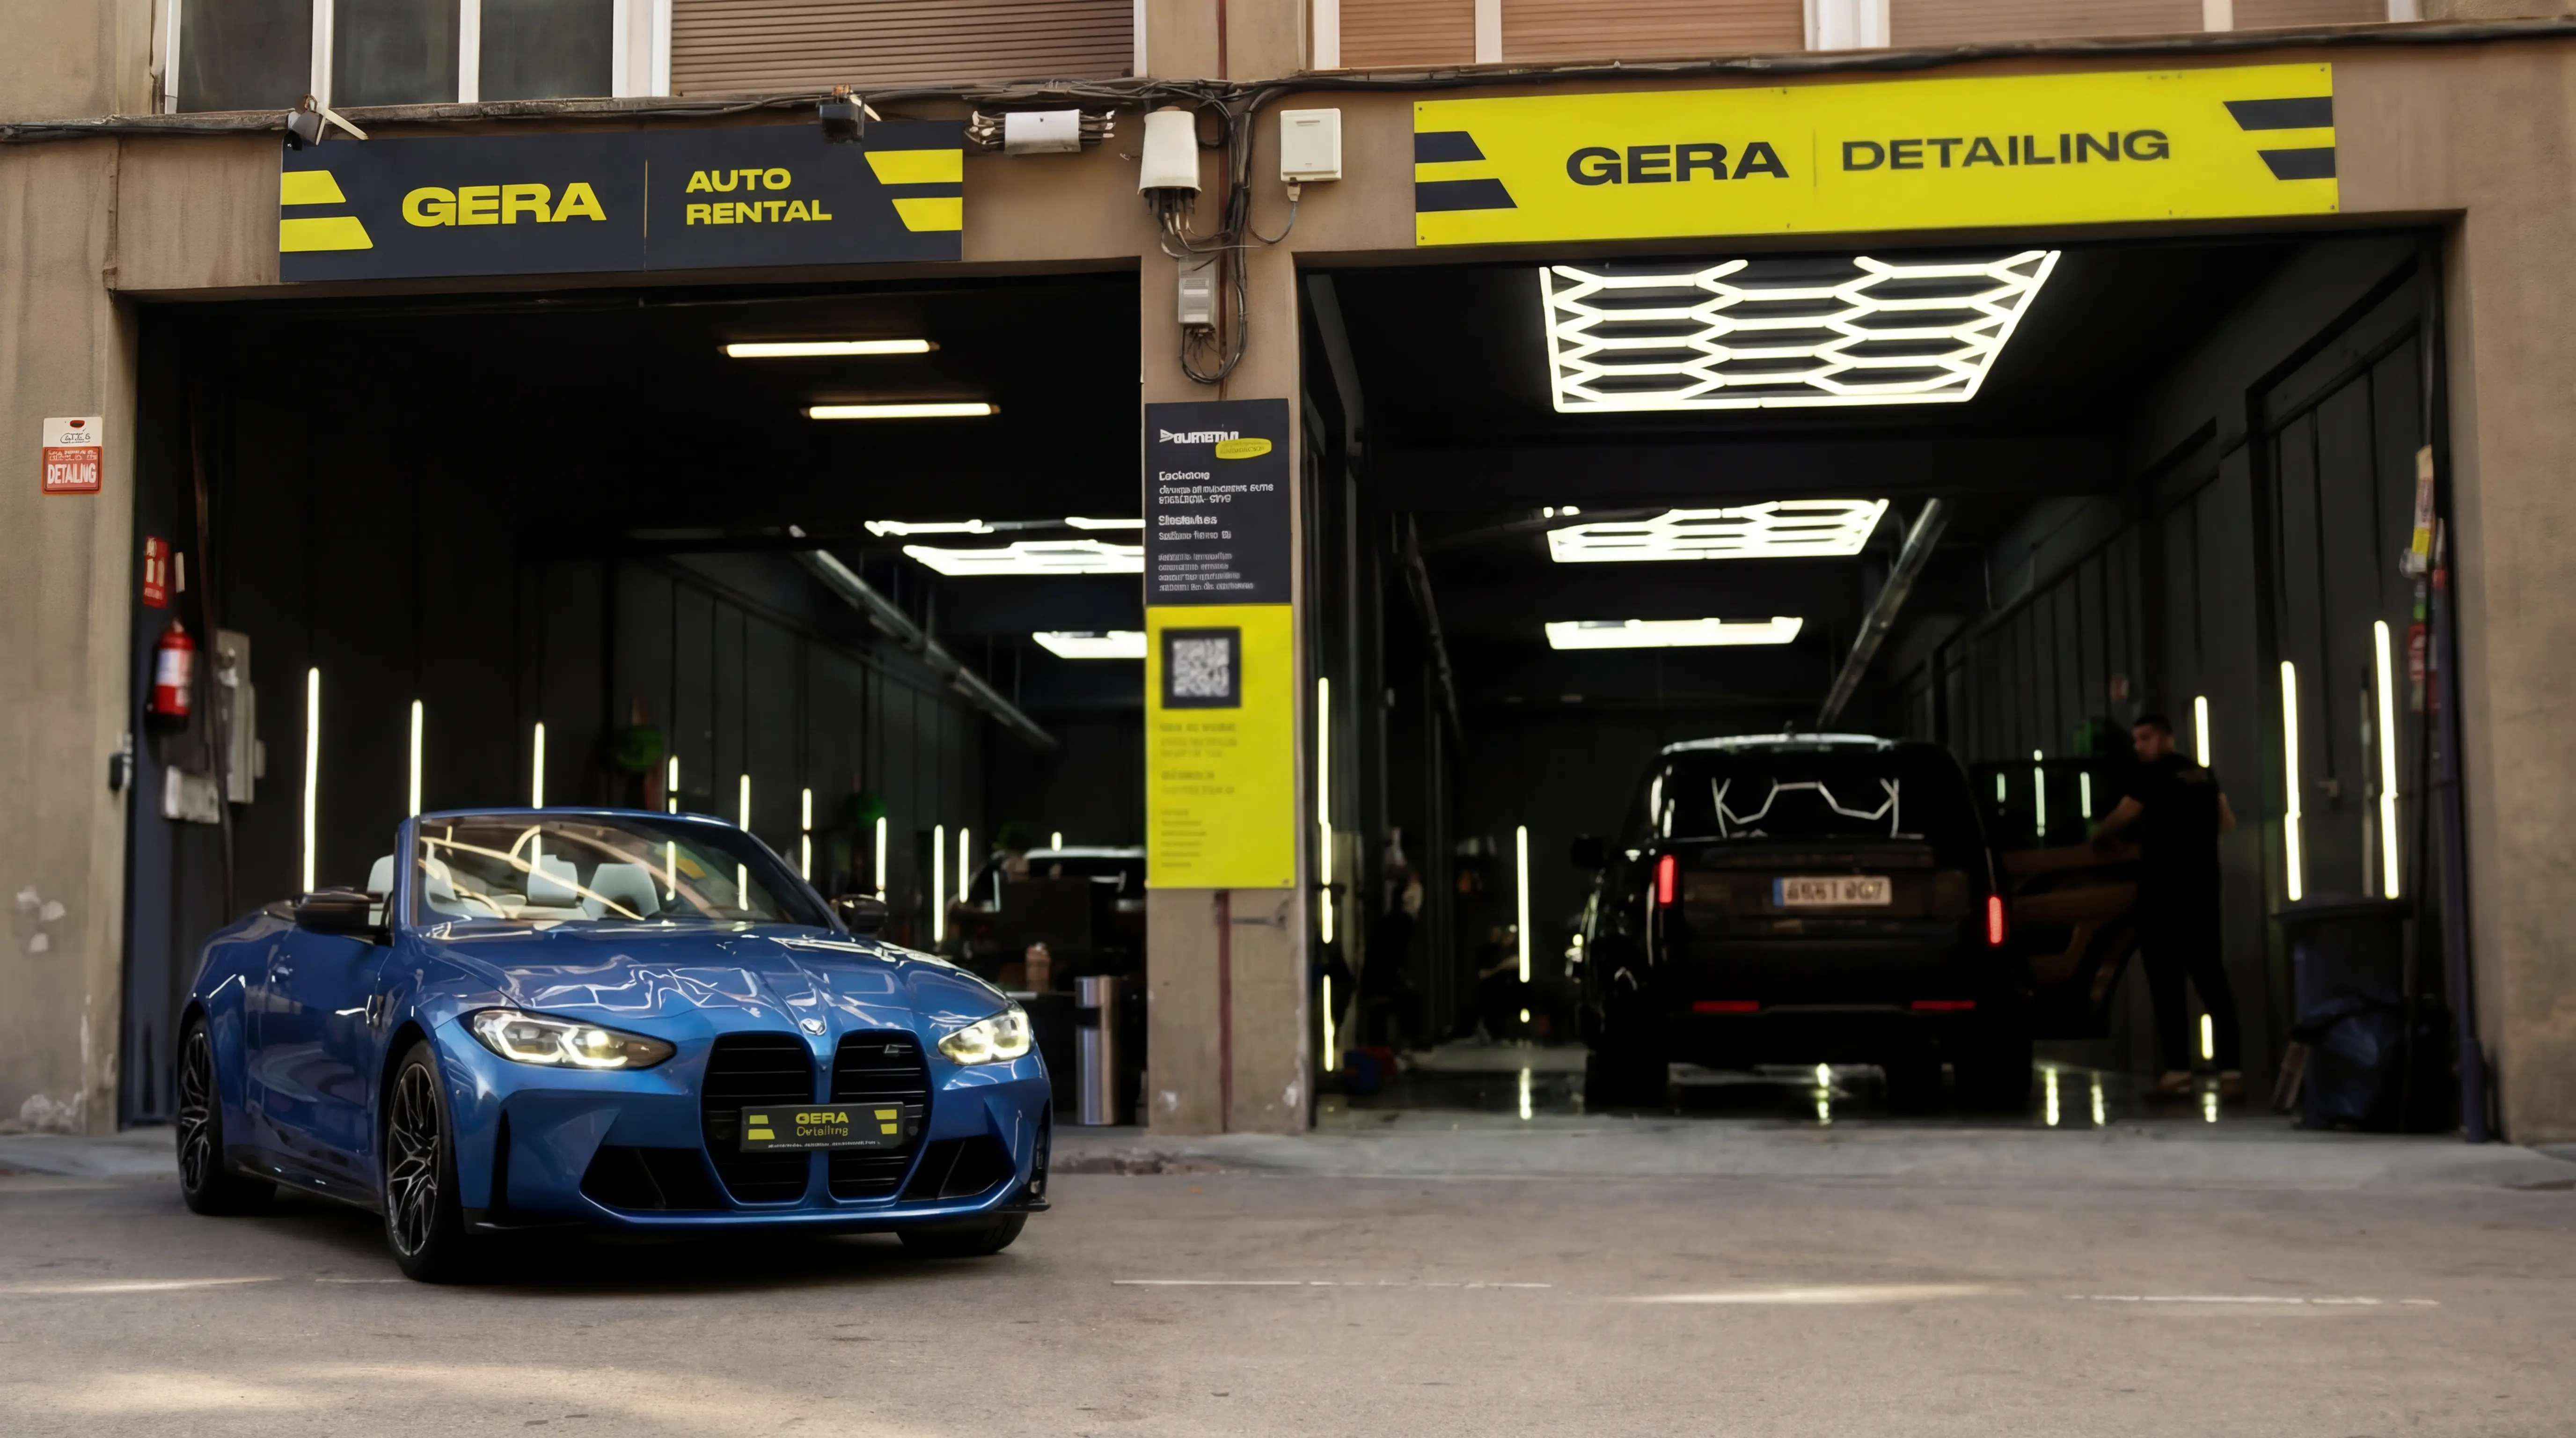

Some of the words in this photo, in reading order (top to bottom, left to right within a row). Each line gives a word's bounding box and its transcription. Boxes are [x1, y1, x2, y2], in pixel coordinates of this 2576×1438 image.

[1566, 141, 1790, 186] GERA
[1842, 129, 2170, 171] DETAILING
[686, 167, 792, 193] AUTO
[402, 182, 607, 227] GERA
[686, 199, 833, 226] RENTAL
